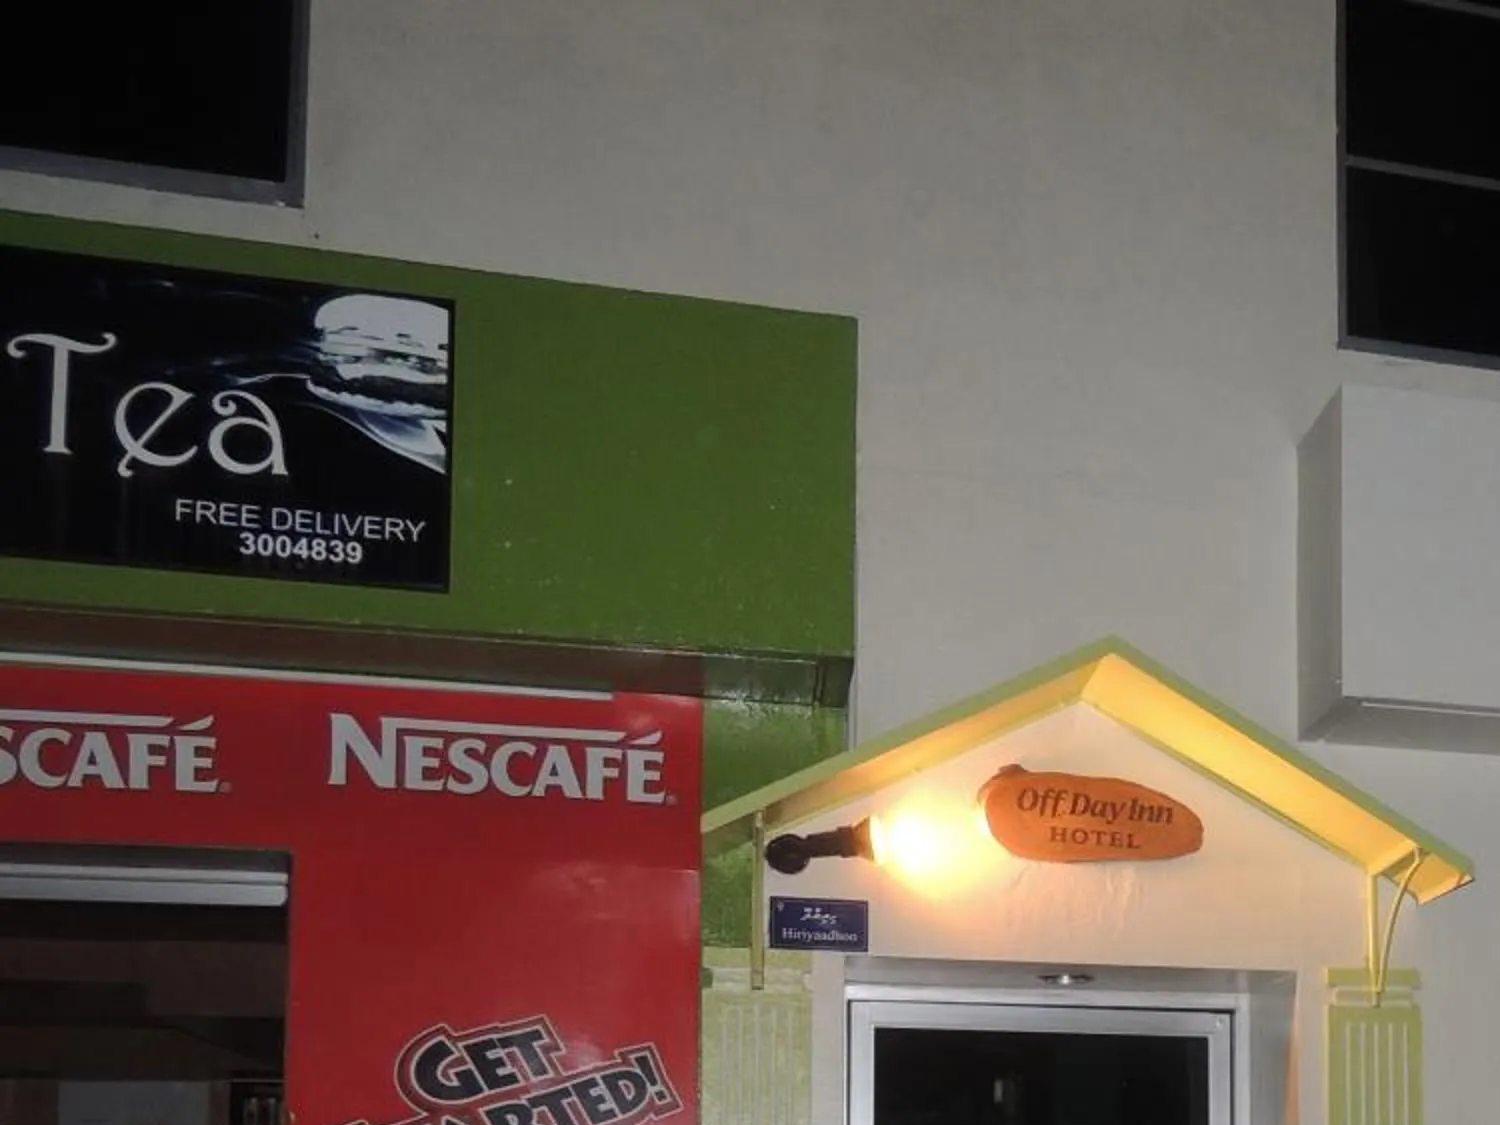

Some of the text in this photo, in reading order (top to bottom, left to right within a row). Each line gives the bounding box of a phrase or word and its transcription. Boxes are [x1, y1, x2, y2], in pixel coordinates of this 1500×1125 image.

[6, 332, 289, 478] Tea
[175, 499, 426, 542] FREE DELIVERY
[239, 532, 363, 565] 3004839
[328, 712, 667, 804] NESCAFÉ
[1017, 786, 1173, 825] Off Day Inn
[1049, 826, 1142, 849] HOTEL
[412, 1026, 551, 1104] GET
